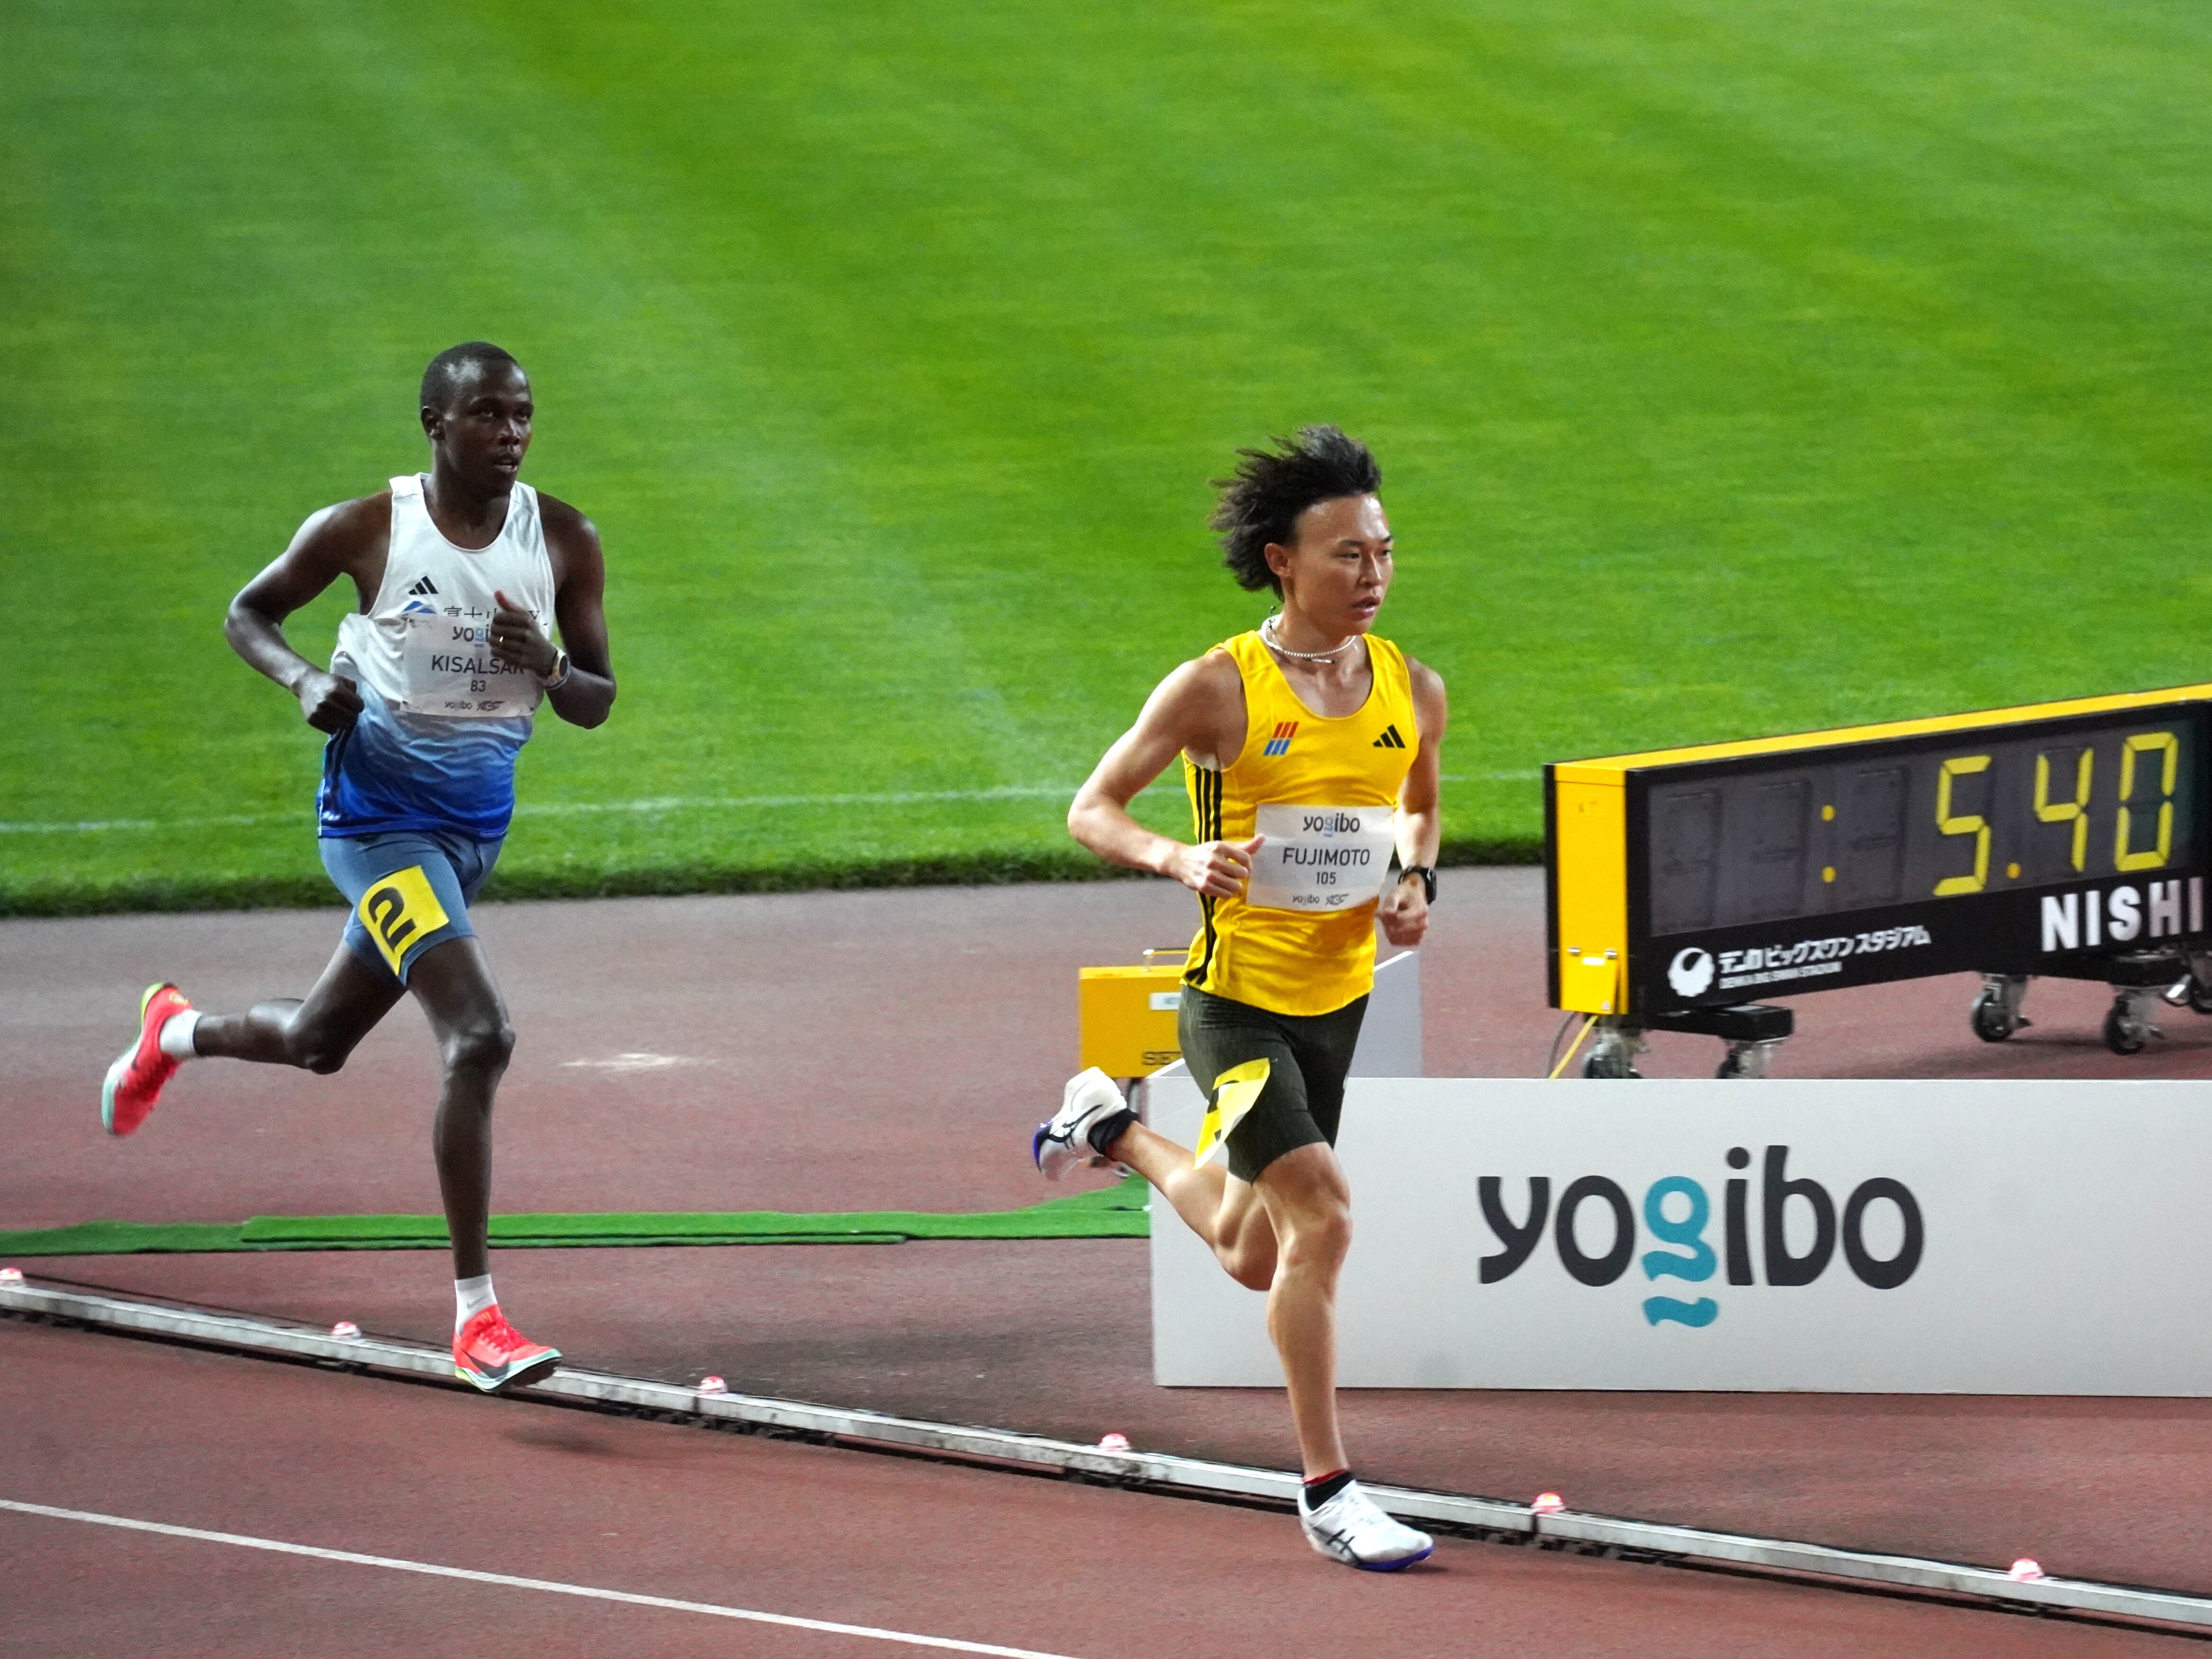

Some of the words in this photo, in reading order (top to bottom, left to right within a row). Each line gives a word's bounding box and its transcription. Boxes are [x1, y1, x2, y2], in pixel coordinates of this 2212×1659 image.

[452, 624, 490, 648] yogi
[470, 680, 486, 692] 83
[1302, 812, 1360, 838] yogibo
[1282, 847, 1370, 866] FUJIMOTO
[1316, 872, 1336, 885] 105
[368, 886, 417, 954] 2
[2041, 877, 2204, 952] NISHI
[1477, 1144, 1924, 1328] yogibo
